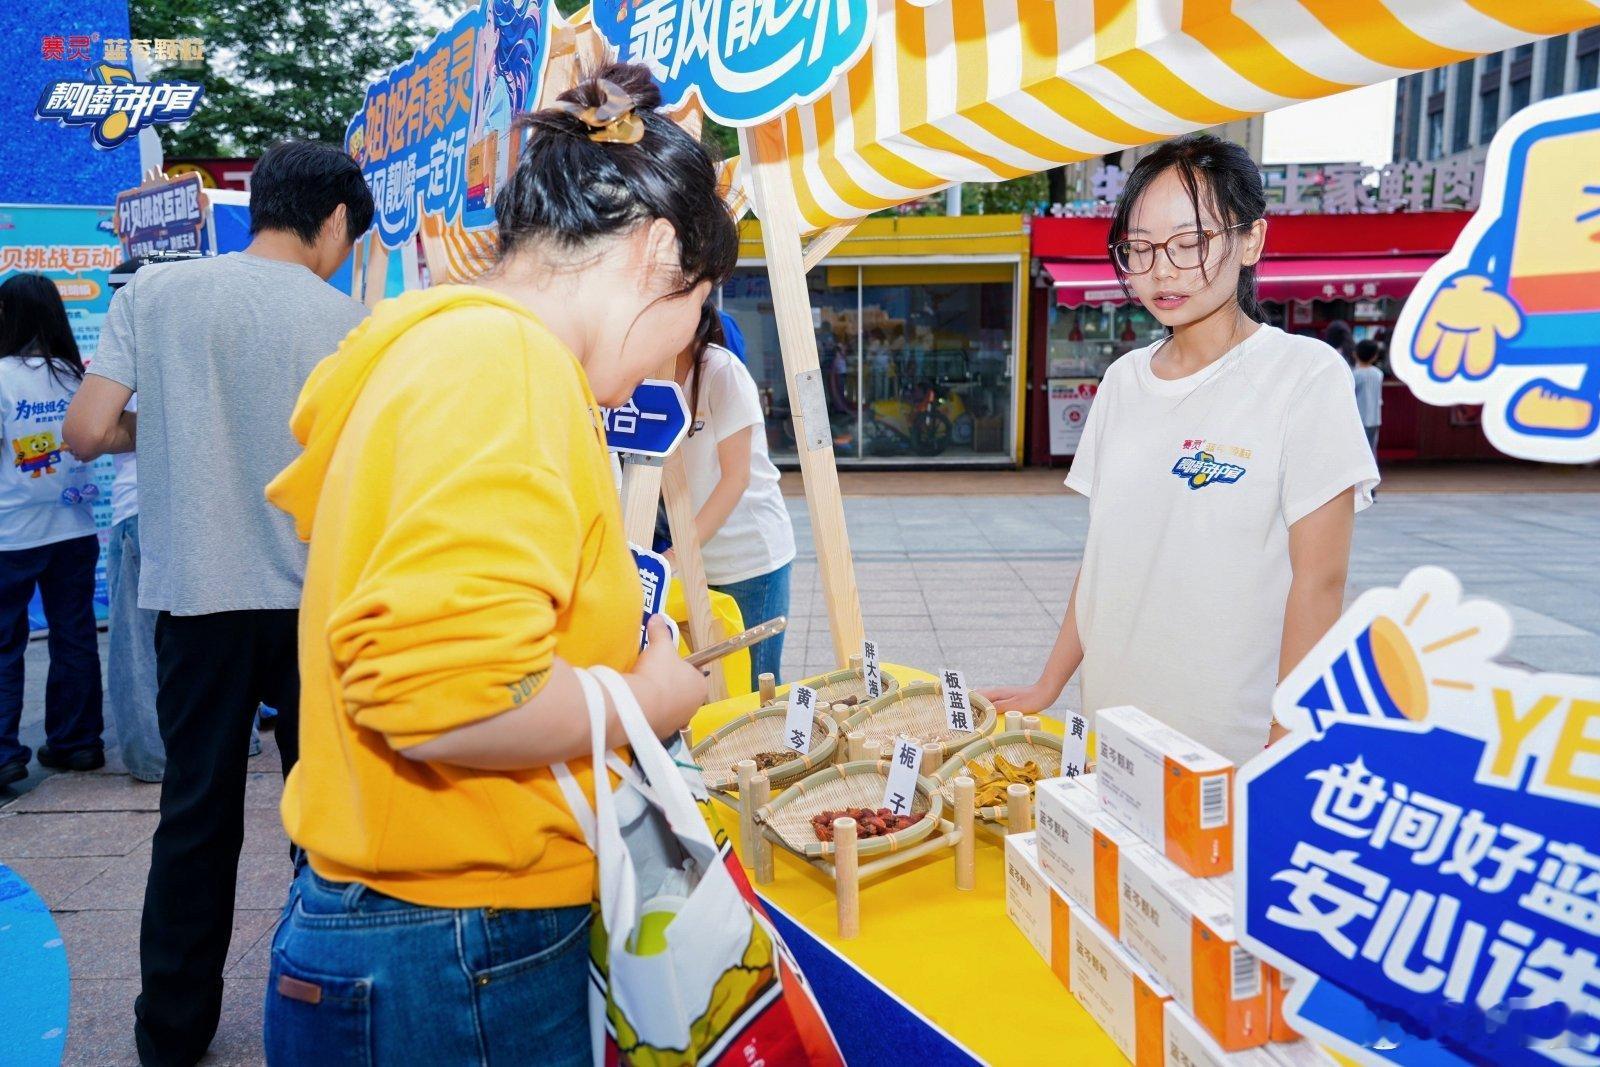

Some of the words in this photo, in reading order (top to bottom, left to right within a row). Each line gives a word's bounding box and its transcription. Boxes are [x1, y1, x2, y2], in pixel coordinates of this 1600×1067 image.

[119, 183, 201, 238] 分贝挑战互动区
[864, 640, 880, 699] 胖大海
[944, 670, 969, 731] 板蓝根
[790, 686, 813, 749] 黄芩
[889, 743, 918, 815] 栀子
[1304, 754, 1600, 938] 世间好蓝
